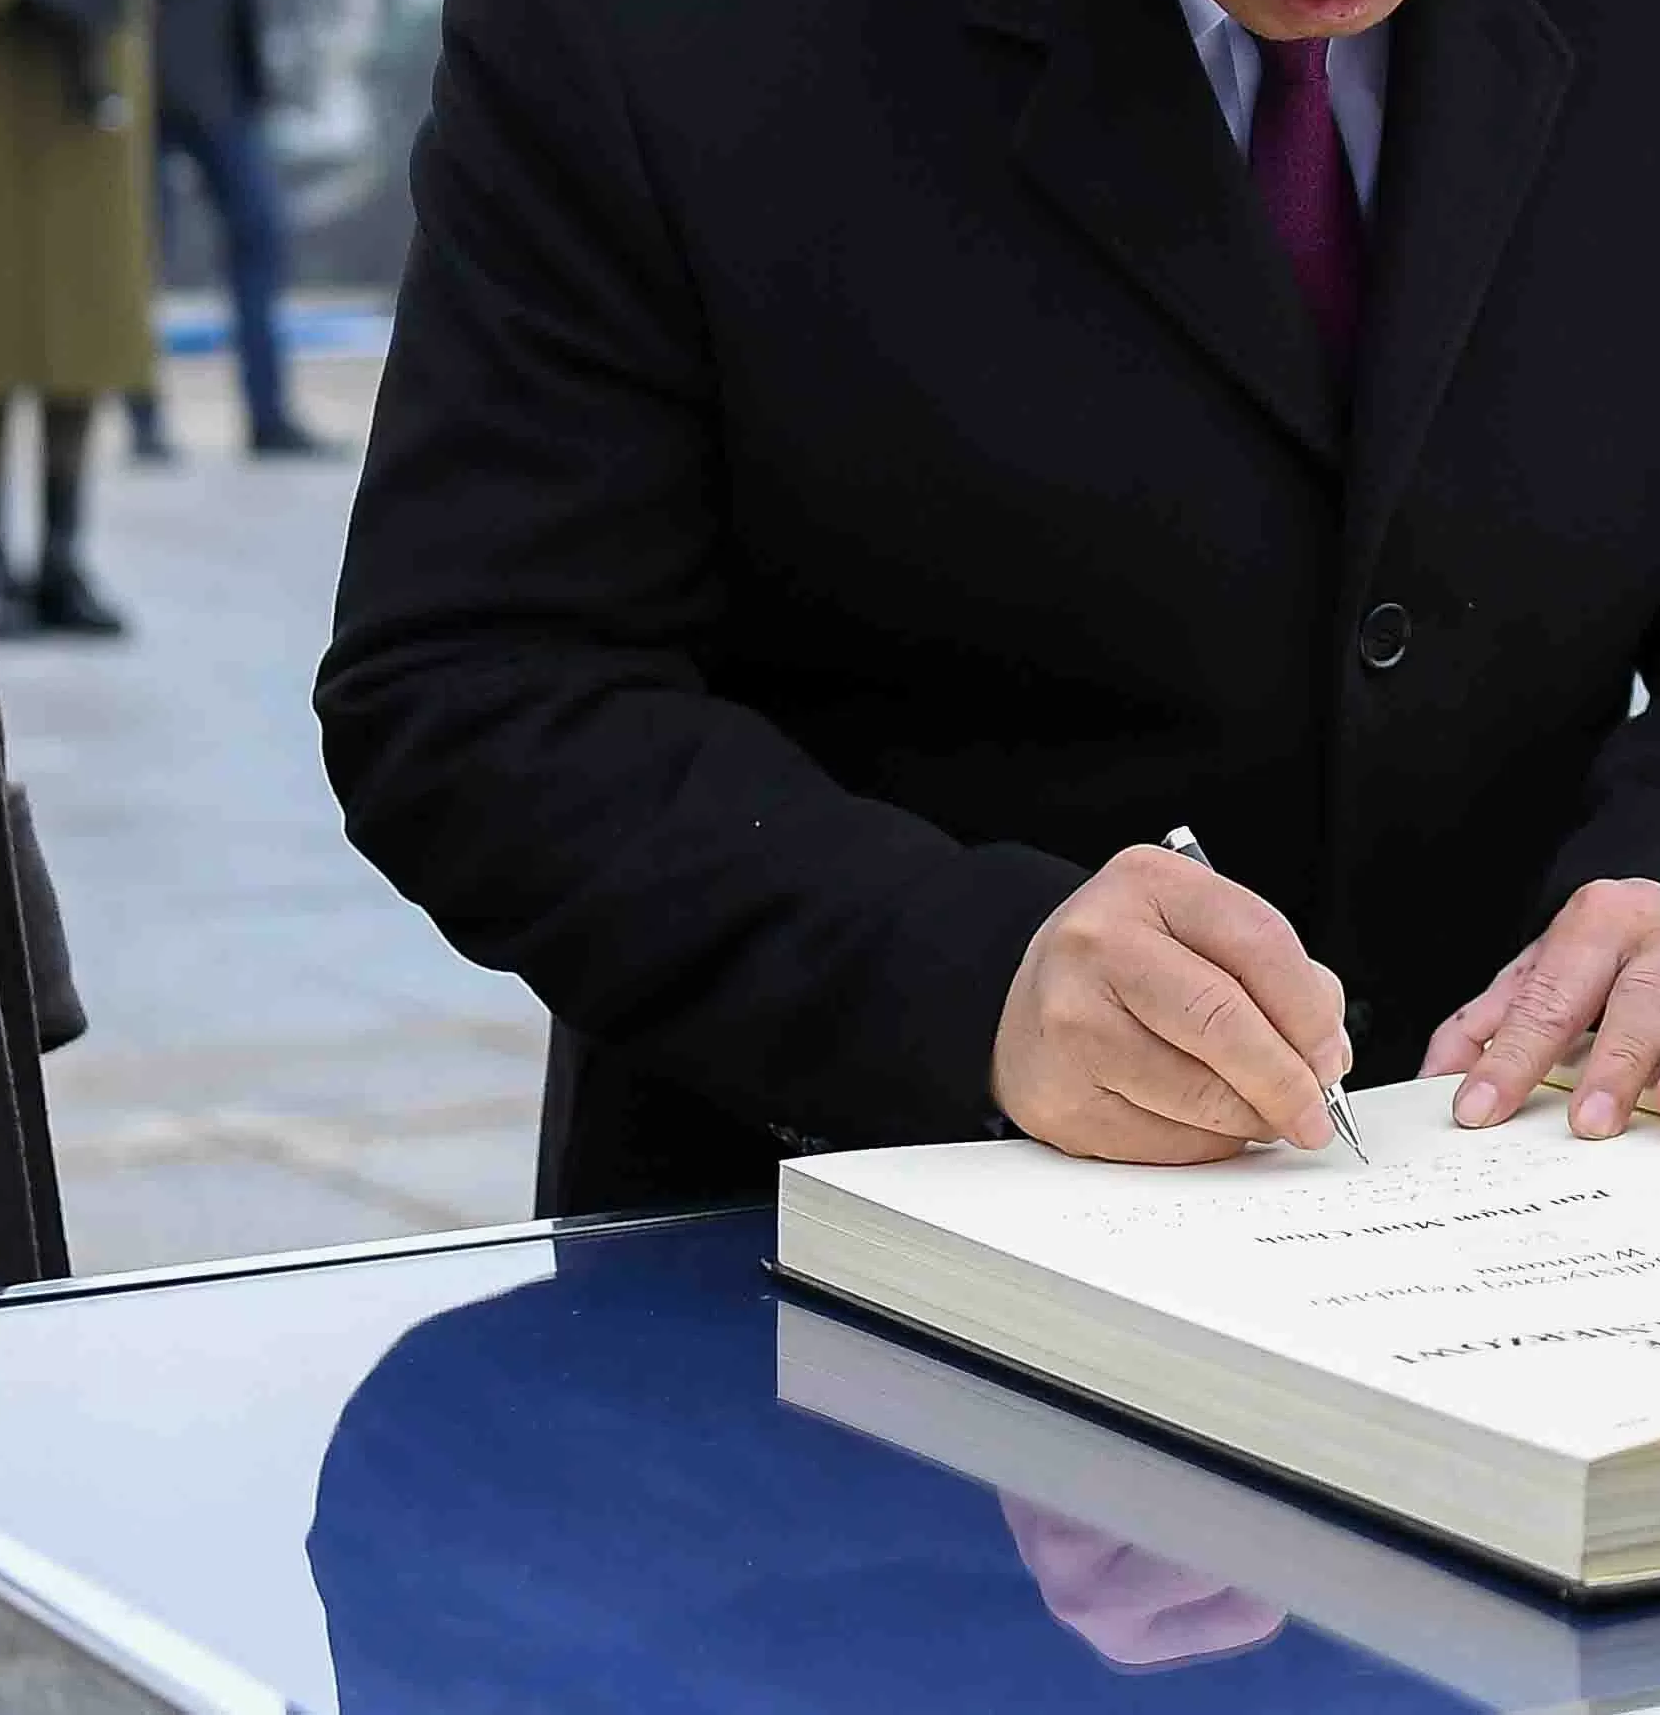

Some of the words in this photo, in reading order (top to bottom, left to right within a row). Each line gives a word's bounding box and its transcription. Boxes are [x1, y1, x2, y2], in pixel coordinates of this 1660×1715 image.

[1548, 1188, 1612, 1207] Pan
[1360, 1218, 1447, 1238] Minh
[1471, 1247, 1645, 1277] Wietnamu
